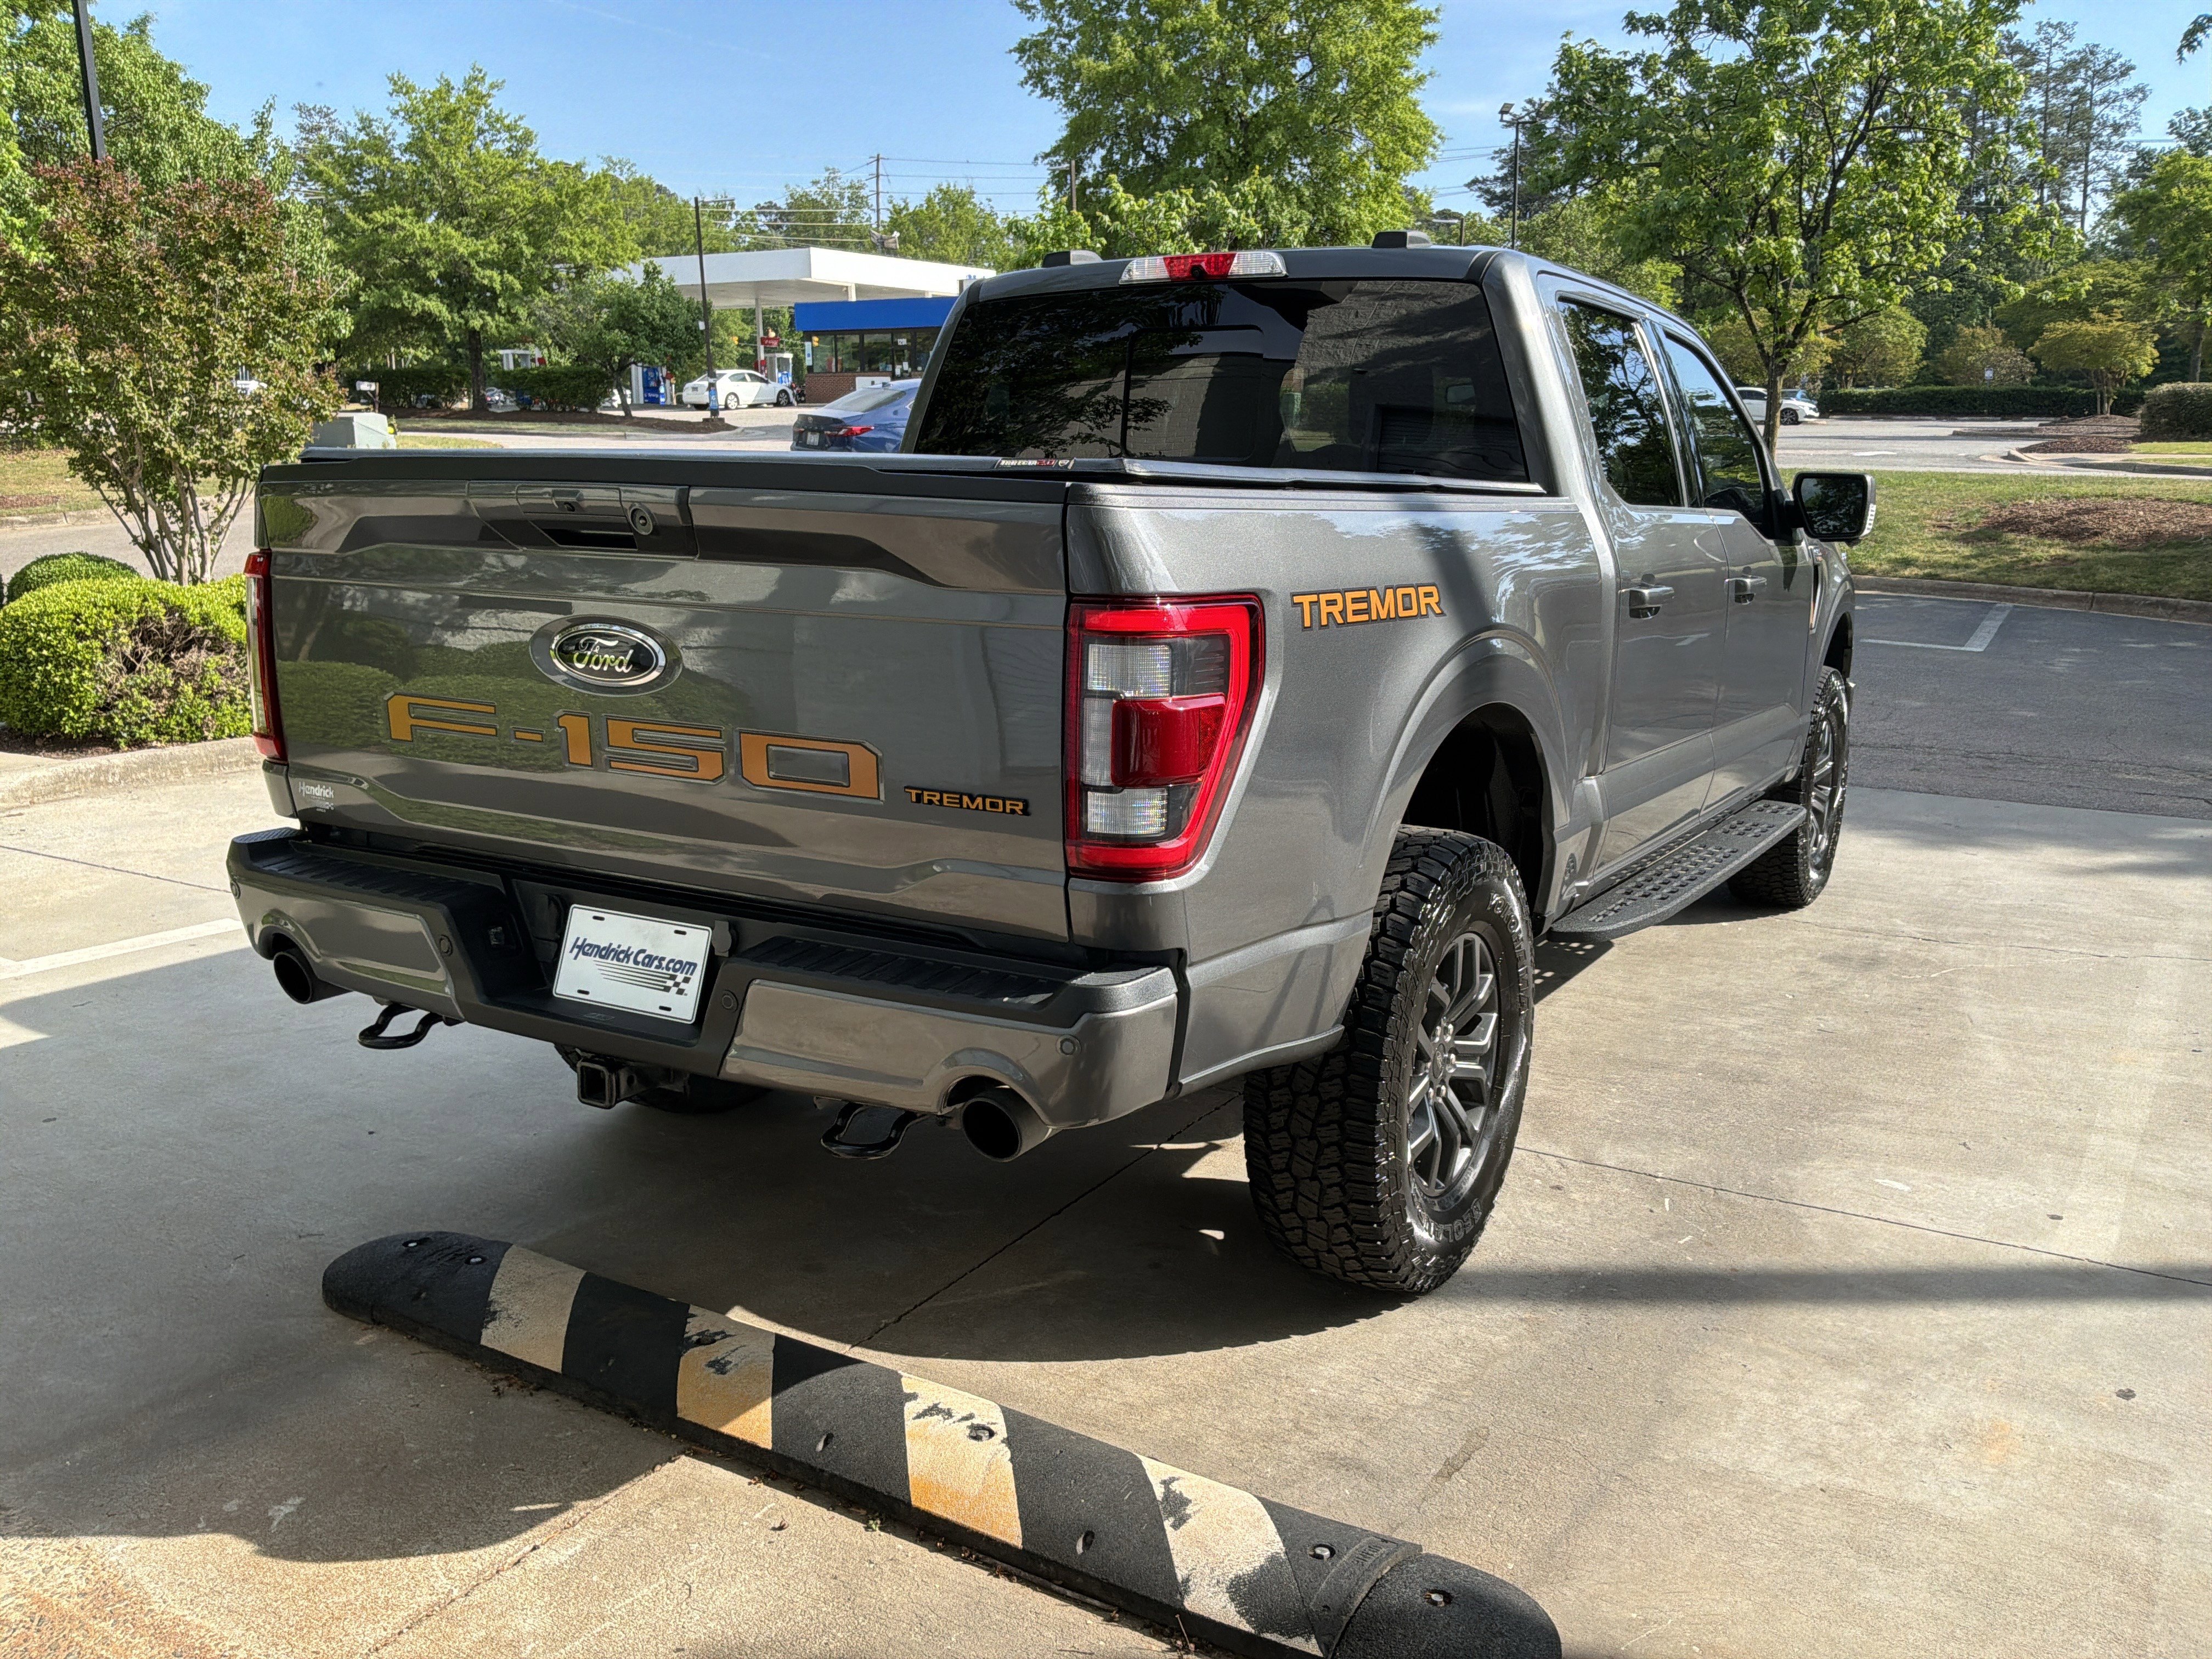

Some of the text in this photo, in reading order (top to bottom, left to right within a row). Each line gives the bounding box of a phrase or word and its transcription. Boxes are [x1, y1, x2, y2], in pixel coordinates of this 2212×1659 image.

[1291, 585, 1444, 629] TREMOR
[573, 636, 634, 673] Ford
[386, 692, 882, 801] F-150
[298, 781, 334, 798] Hendrick
[905, 787, 1028, 816] TREMOR
